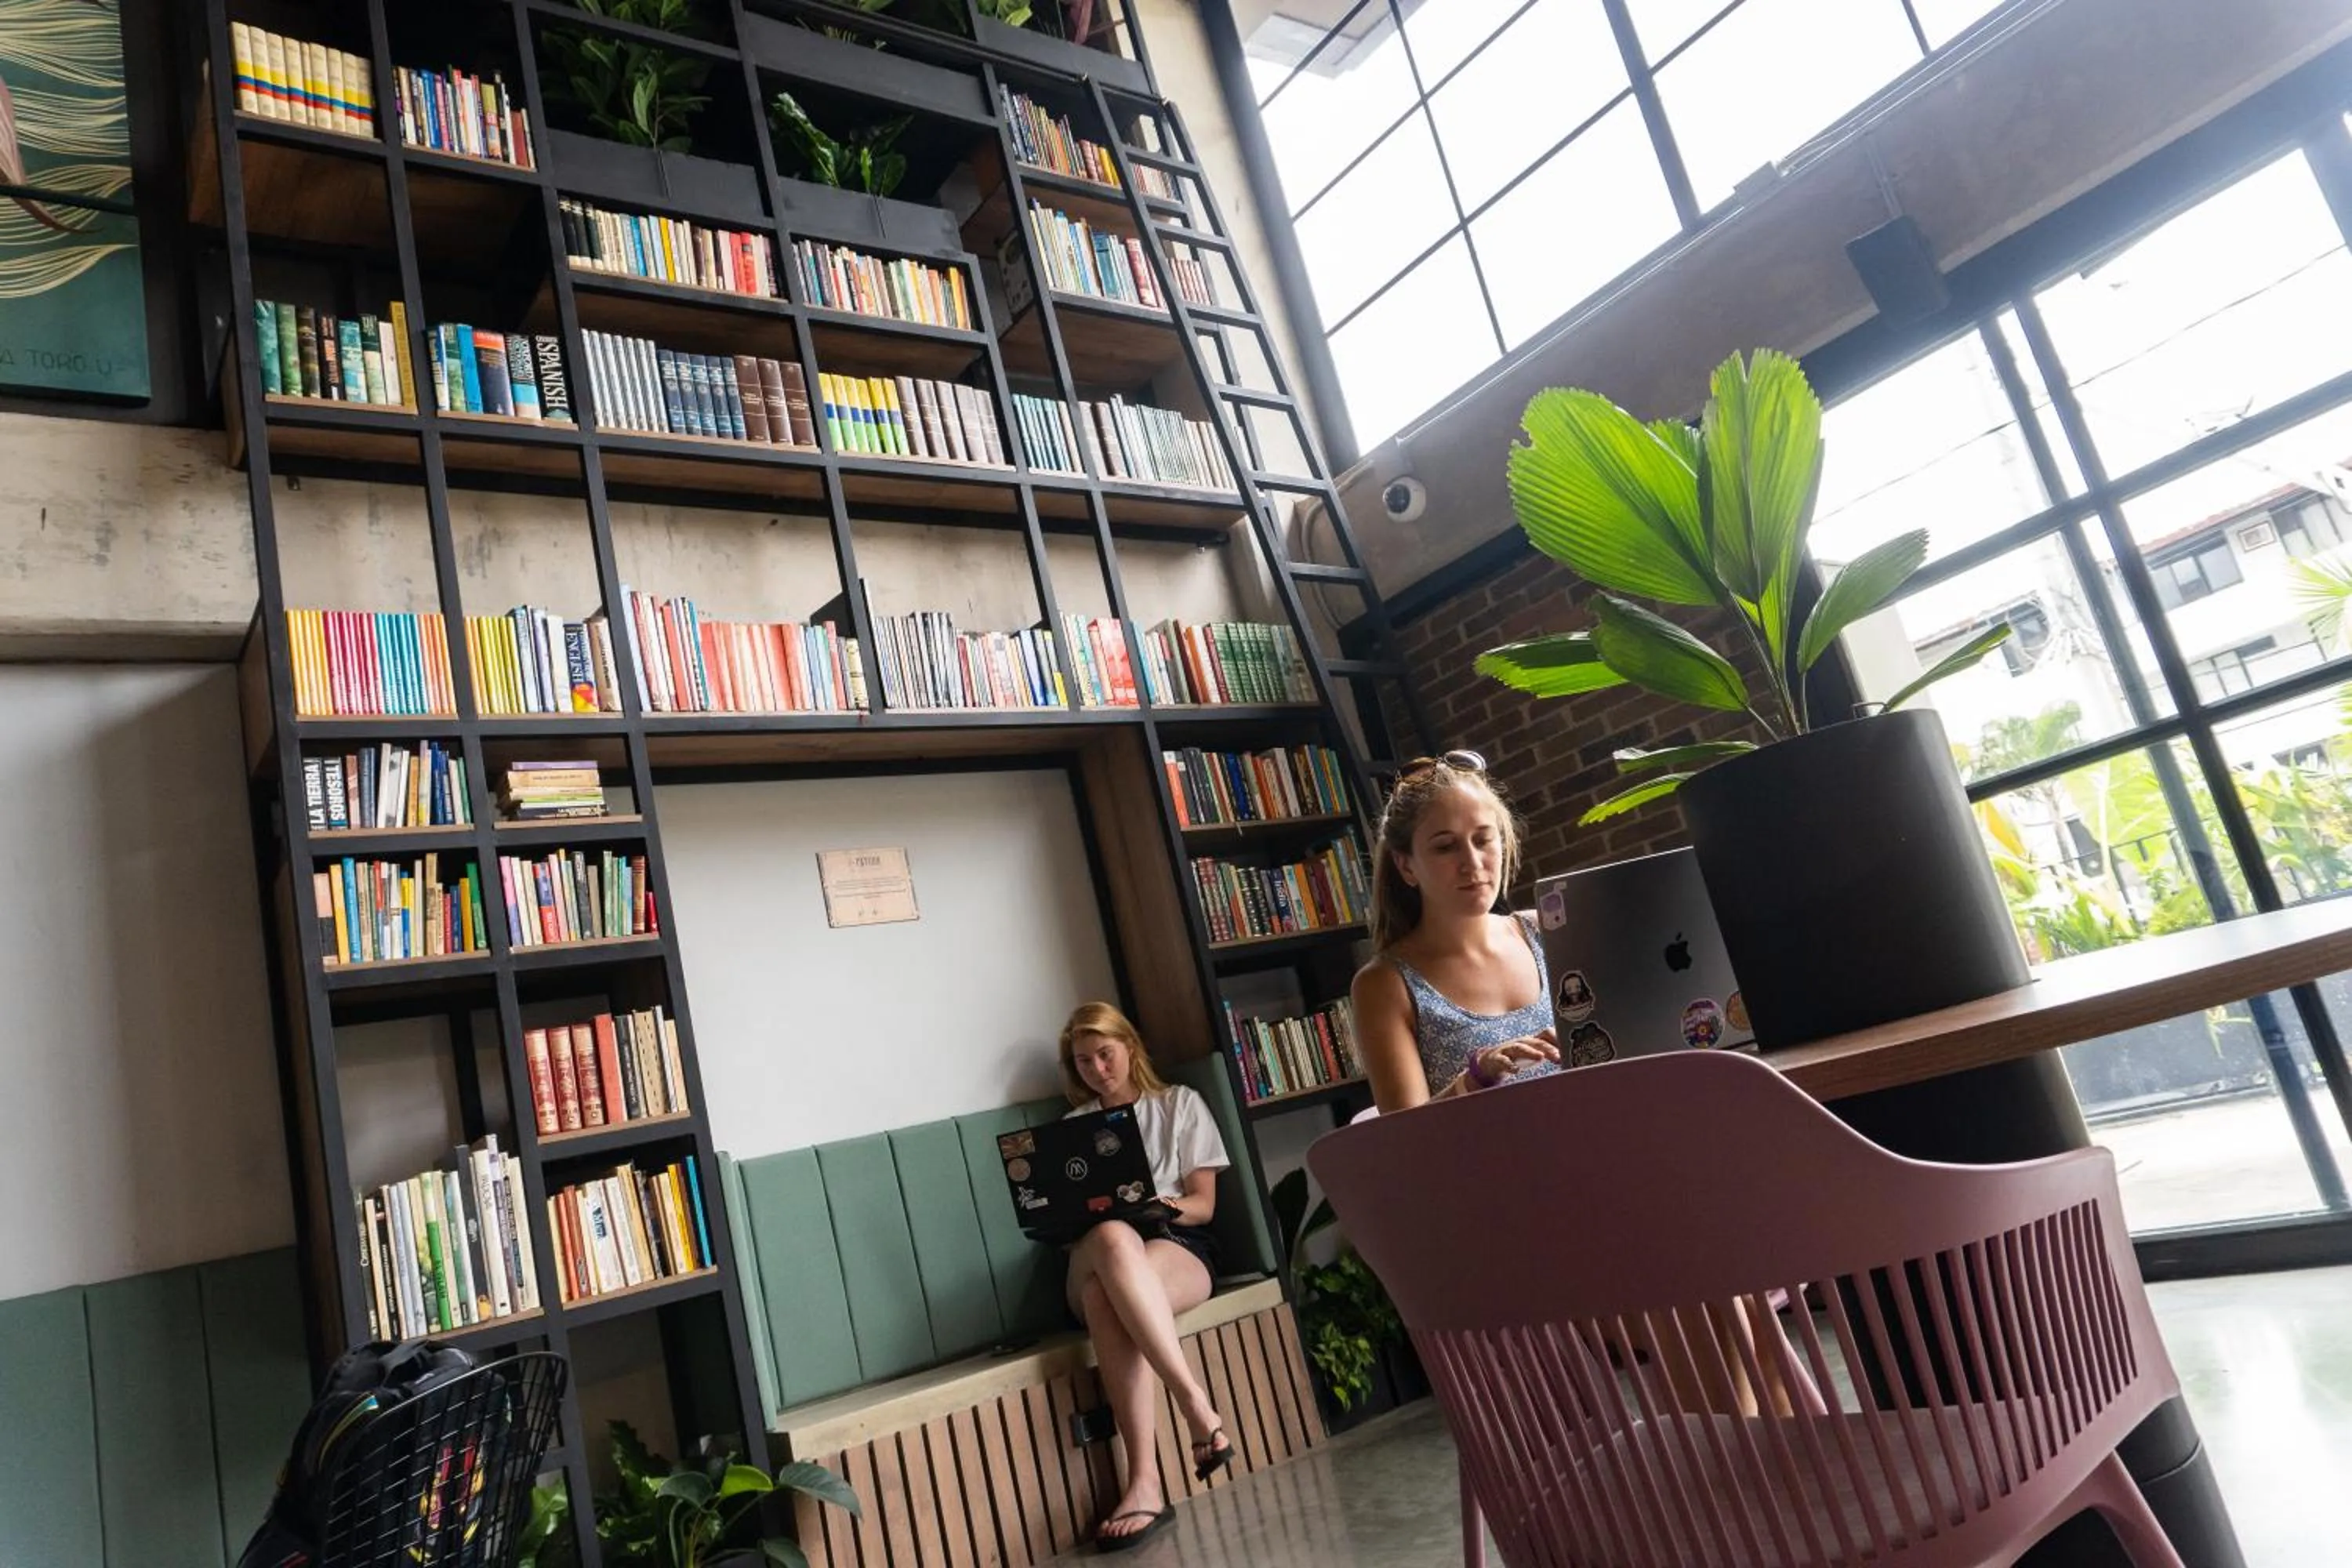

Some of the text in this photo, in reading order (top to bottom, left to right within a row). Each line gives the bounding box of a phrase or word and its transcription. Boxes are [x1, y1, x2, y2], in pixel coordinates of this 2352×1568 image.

[537, 343, 569, 408] SPANISH
[565, 632, 584, 682] ENGLISH
[309, 809, 325, 825] LA
